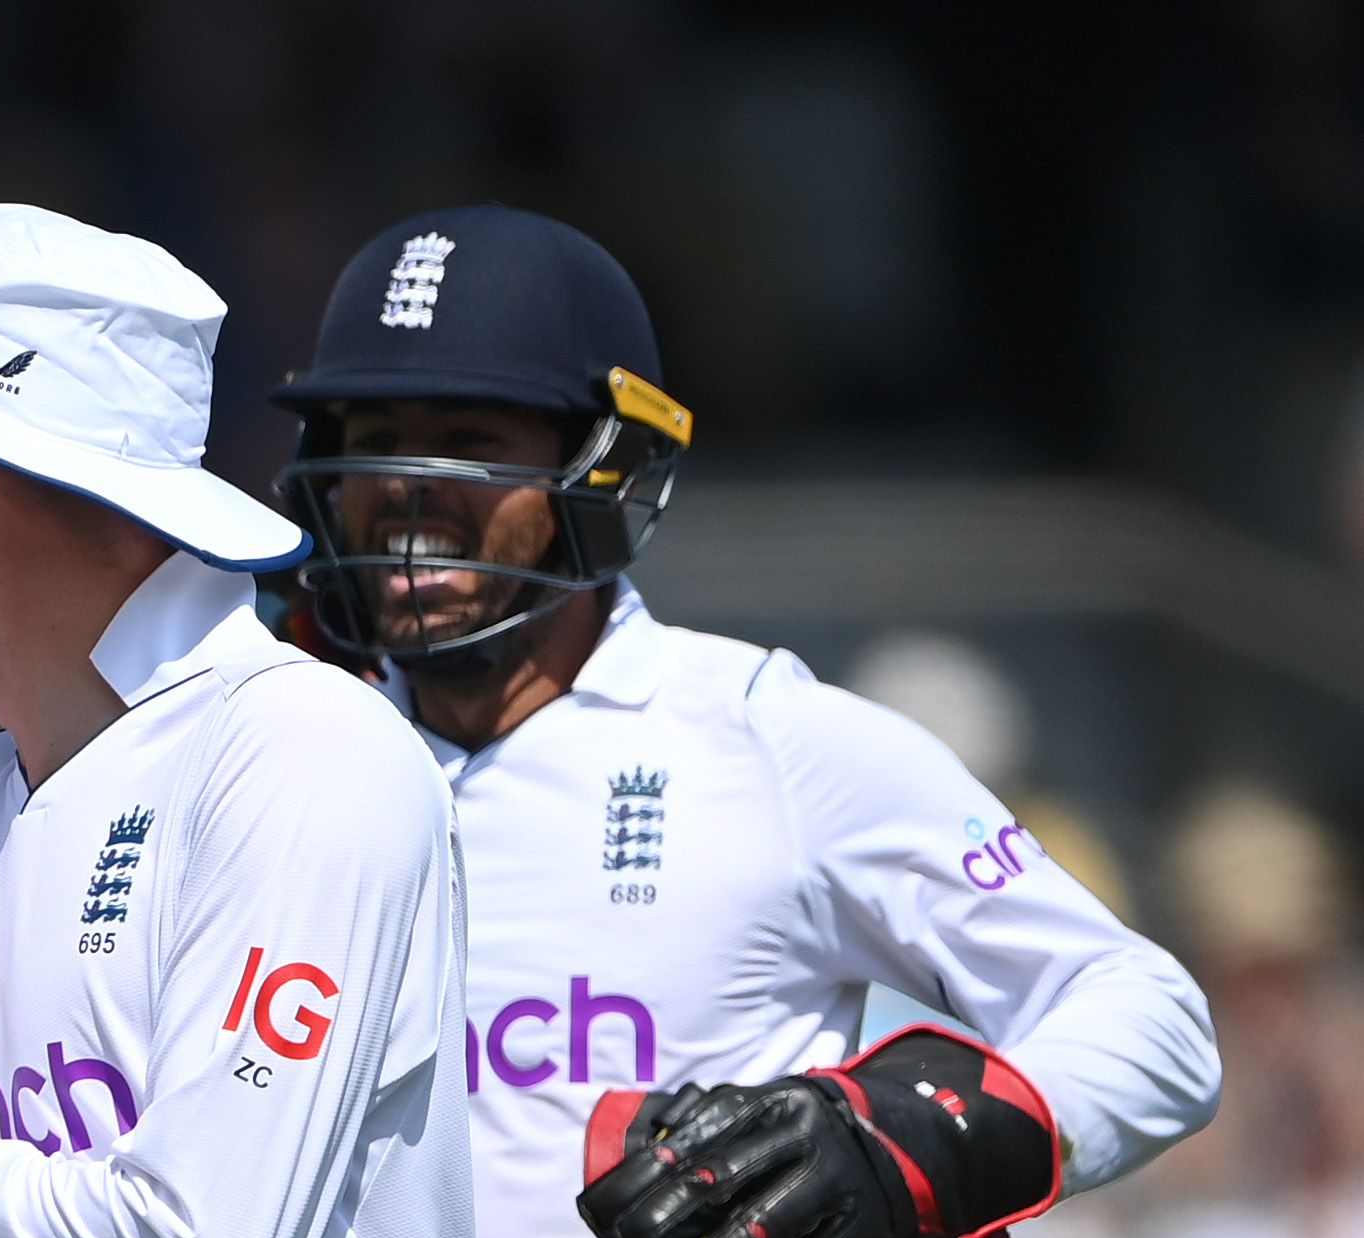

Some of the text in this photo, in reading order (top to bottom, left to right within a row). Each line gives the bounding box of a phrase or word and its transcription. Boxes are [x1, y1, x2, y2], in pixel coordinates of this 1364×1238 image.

[962, 818, 1048, 891] cin
[610, 883, 657, 905] 689
[78, 932, 117, 955] 695
[222, 946, 341, 1061] IG
[466, 975, 658, 1094] ch
[233, 1056, 273, 1089] ZC
